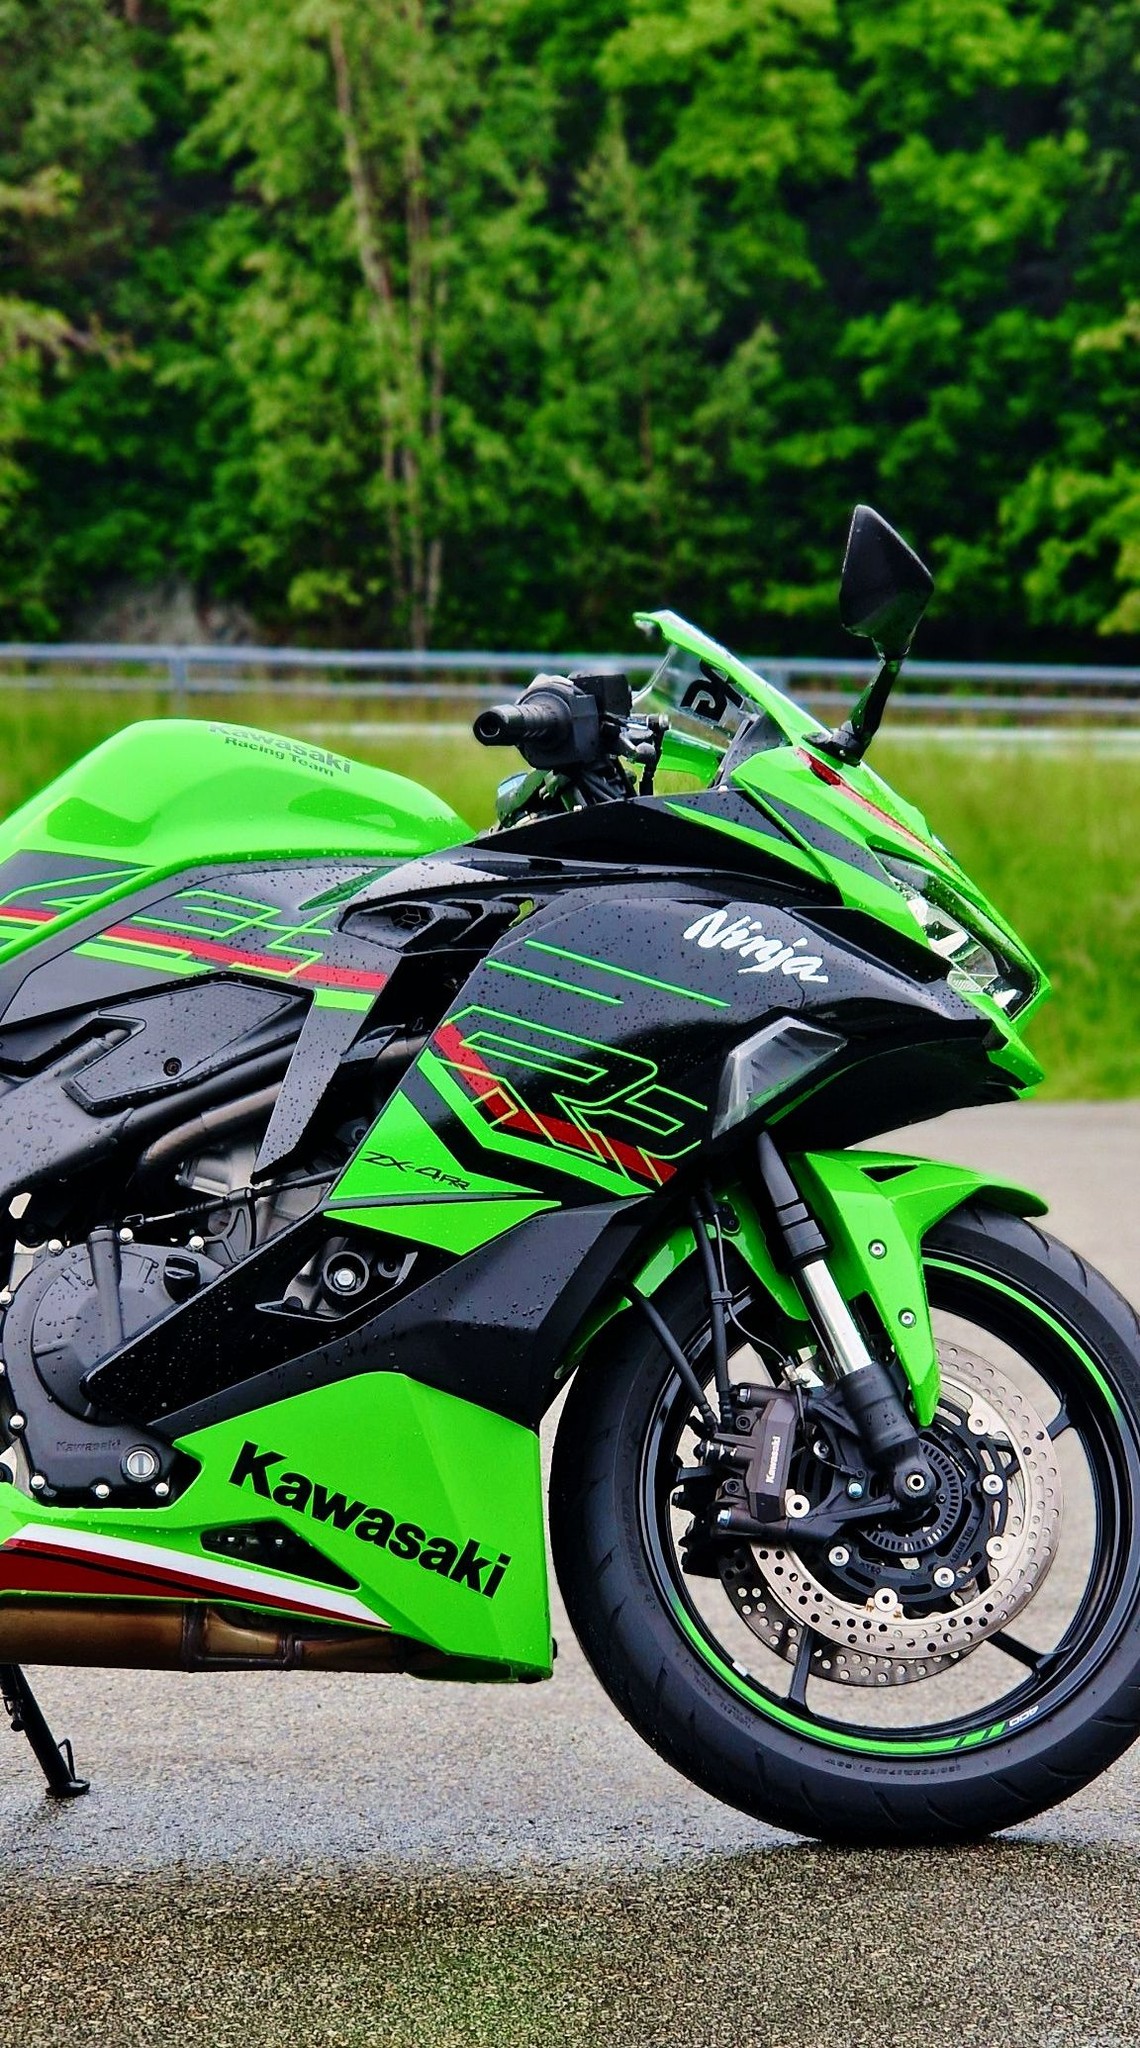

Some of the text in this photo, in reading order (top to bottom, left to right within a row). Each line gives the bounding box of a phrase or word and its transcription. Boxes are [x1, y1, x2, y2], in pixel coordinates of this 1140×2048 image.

[208, 723, 351, 774] Kawasaki
[224, 736, 334, 777] Racing Team
[683, 909, 829, 983] Ninja
[360, 1150, 471, 1190] ZX-4RR
[227, 1439, 512, 1600] Kawasaki
